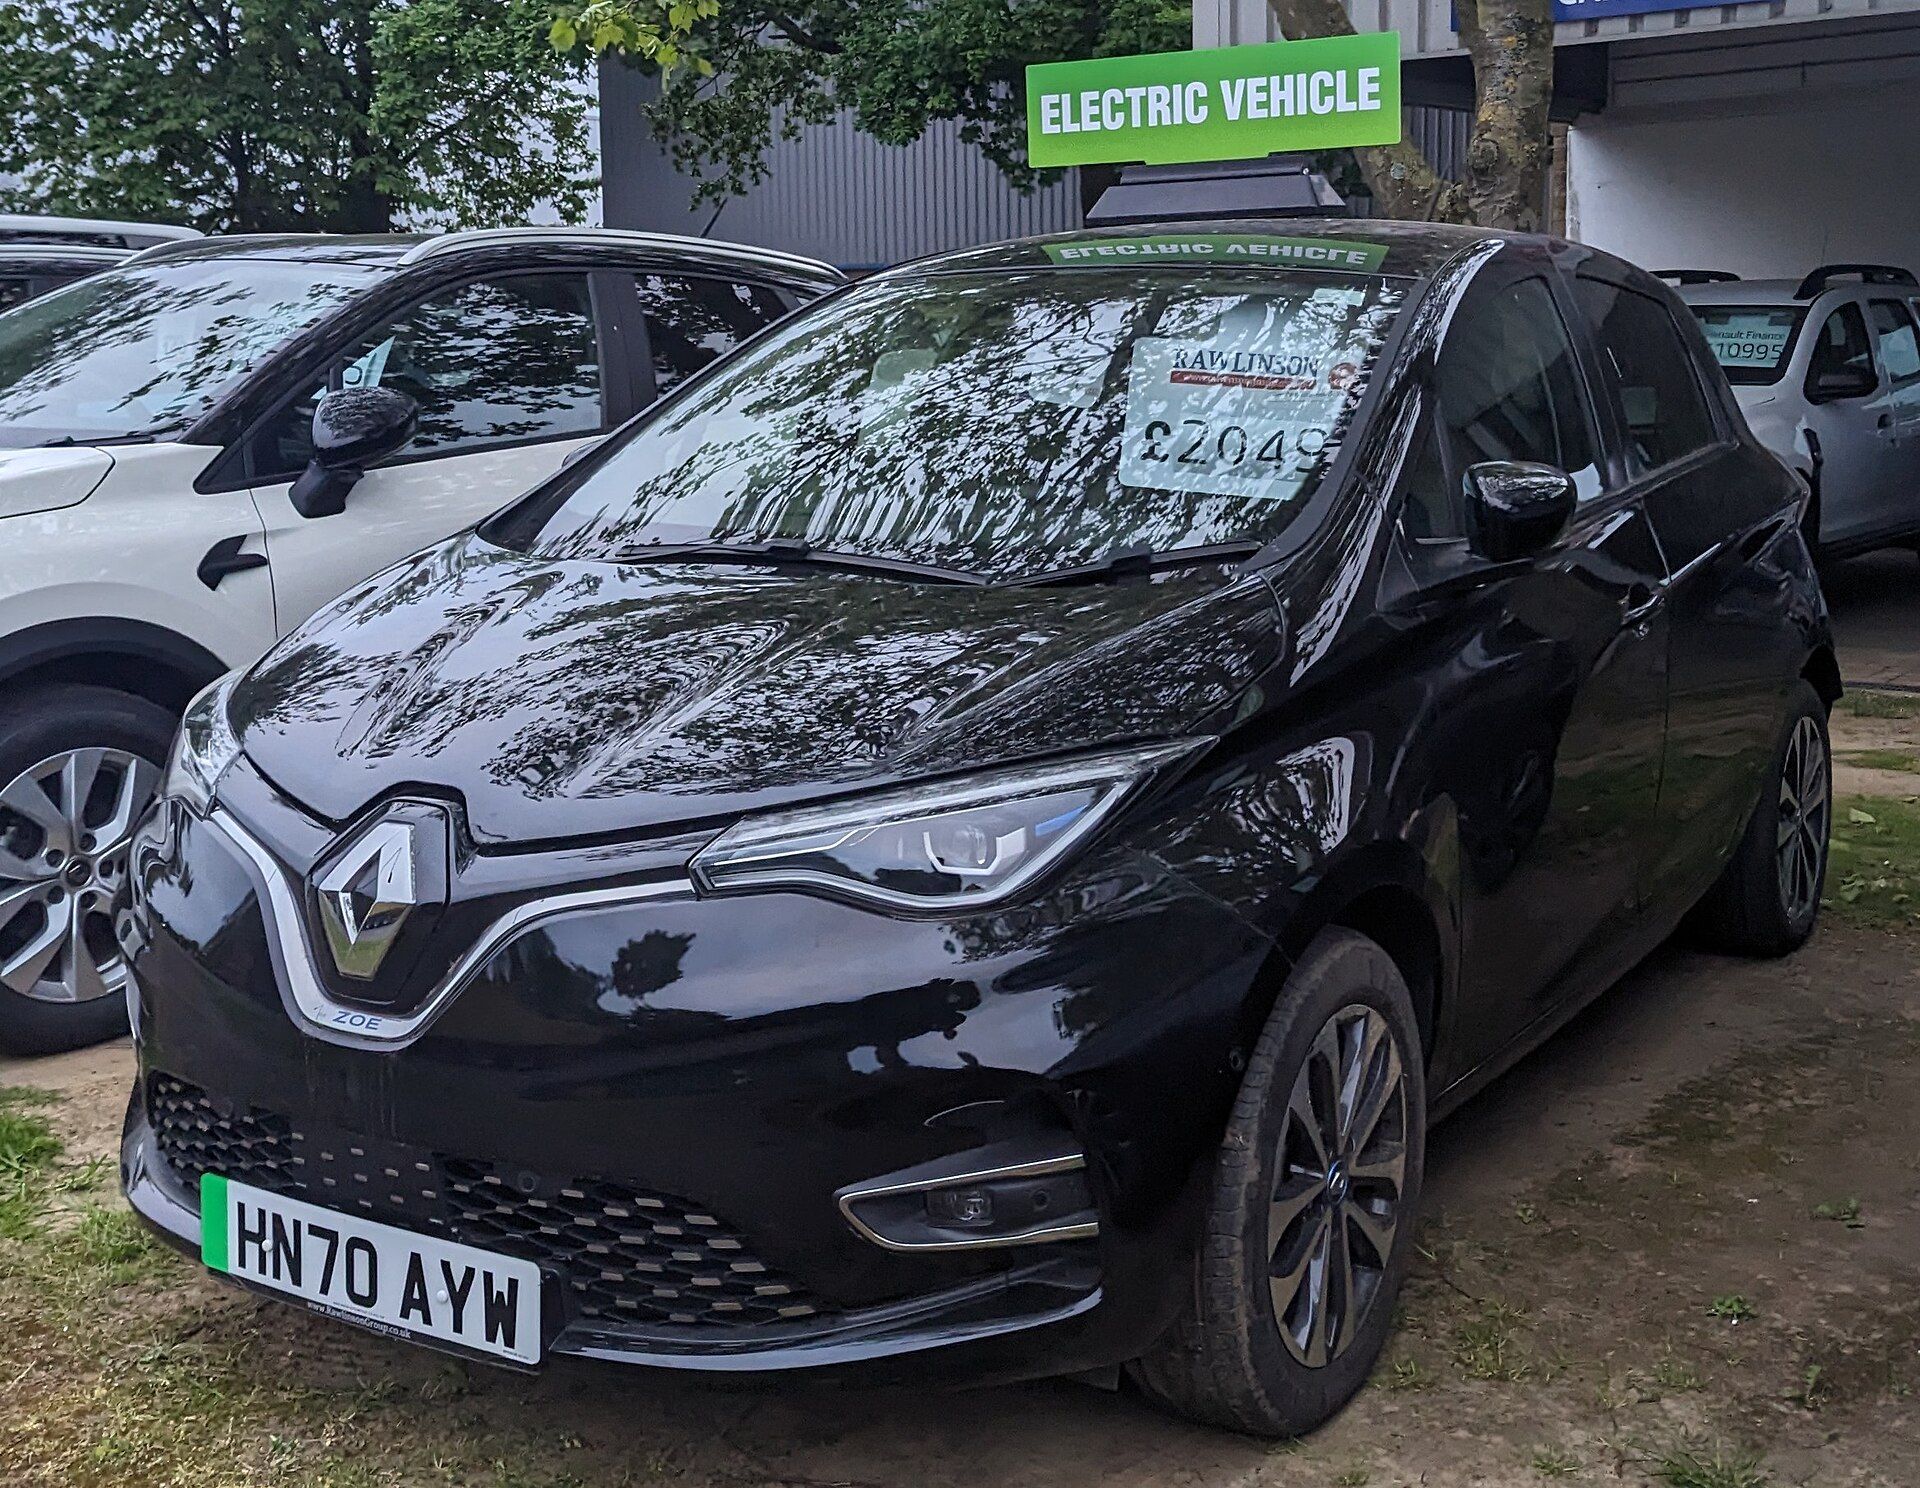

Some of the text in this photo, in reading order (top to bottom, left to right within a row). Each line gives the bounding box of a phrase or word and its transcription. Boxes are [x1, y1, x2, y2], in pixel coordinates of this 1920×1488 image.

[1041, 67, 1381, 135] ELECTRIC VEHICLE
[1173, 349, 1319, 377] RAWLINSON
[1709, 343, 1783, 360] 10995
[332, 1011, 382, 1030] ZOE
[237, 1201, 520, 1350] HN70 AYW
